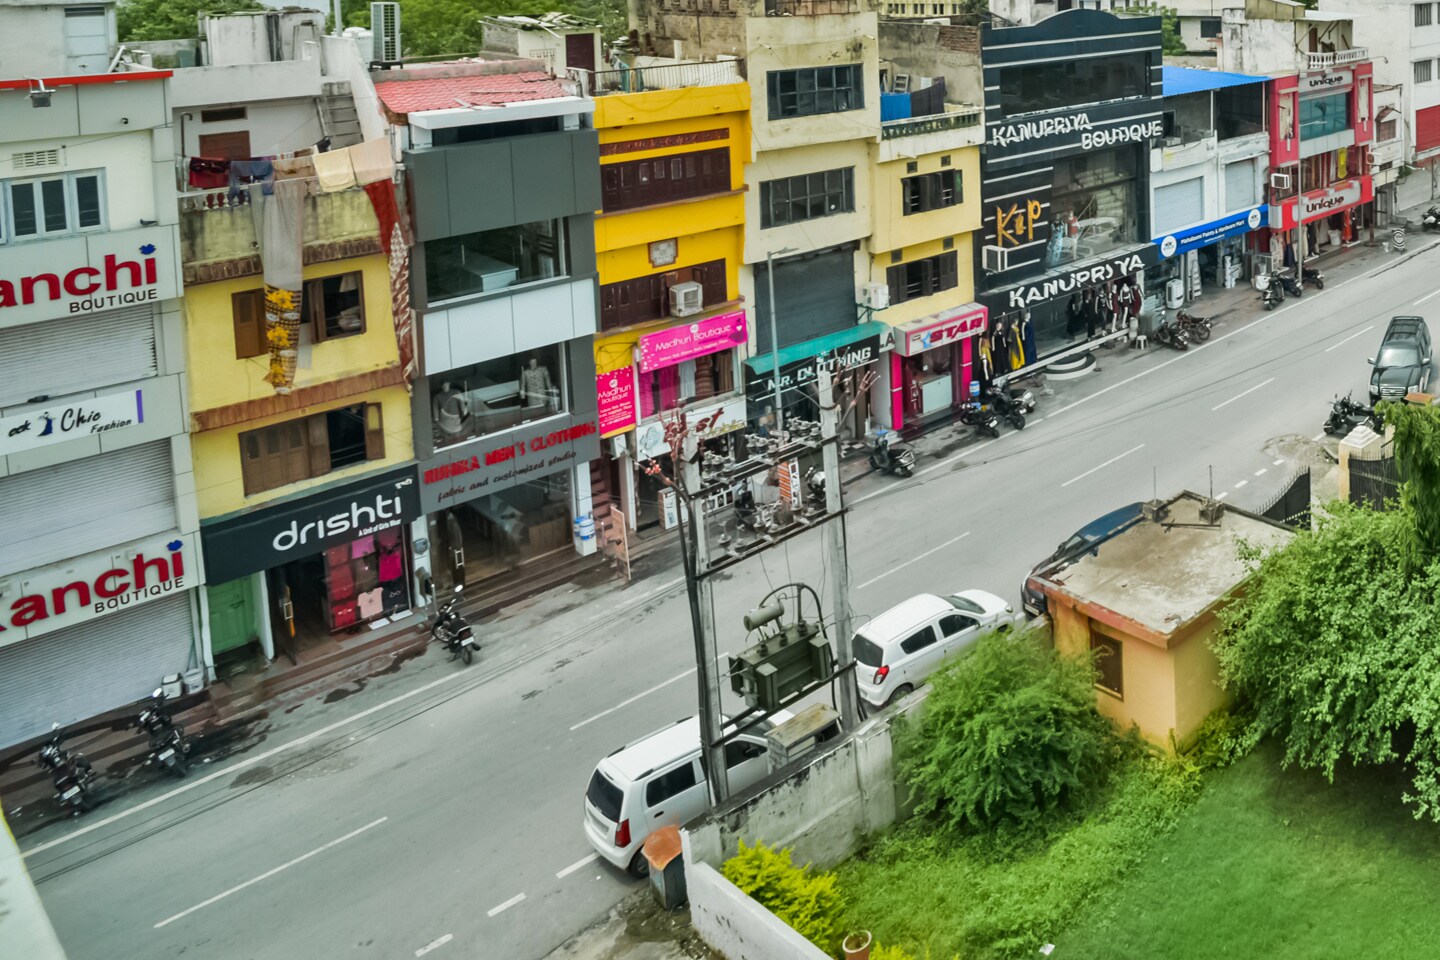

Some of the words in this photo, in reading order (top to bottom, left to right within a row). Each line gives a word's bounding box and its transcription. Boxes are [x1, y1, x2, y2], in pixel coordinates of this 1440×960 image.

[1309, 74, 1343, 87] Unique
[992, 113, 1093, 147] KANUPRIYA
[1081, 120, 1163, 150] BOUTIQUE
[1306, 196, 1344, 213] Unique
[1009, 255, 1145, 308] KANUPRIYA
[70, 288, 157, 313] BOUTIQUE
[693, 324, 733, 342] Boutique
[930, 317, 984, 343] STAR
[60, 408, 101, 432] Chic
[91, 419, 132, 434] Fashion
[484, 440, 526, 466] MEN'S
[530, 421, 597, 452] CLOTHING
[438, 485, 466, 502] fabric
[469, 477, 489, 490] and
[493, 460, 545, 483] customized
[548, 451, 577, 467] studio
[273, 495, 402, 551] drishti
[94, 577, 184, 614] BOUTIQUE
